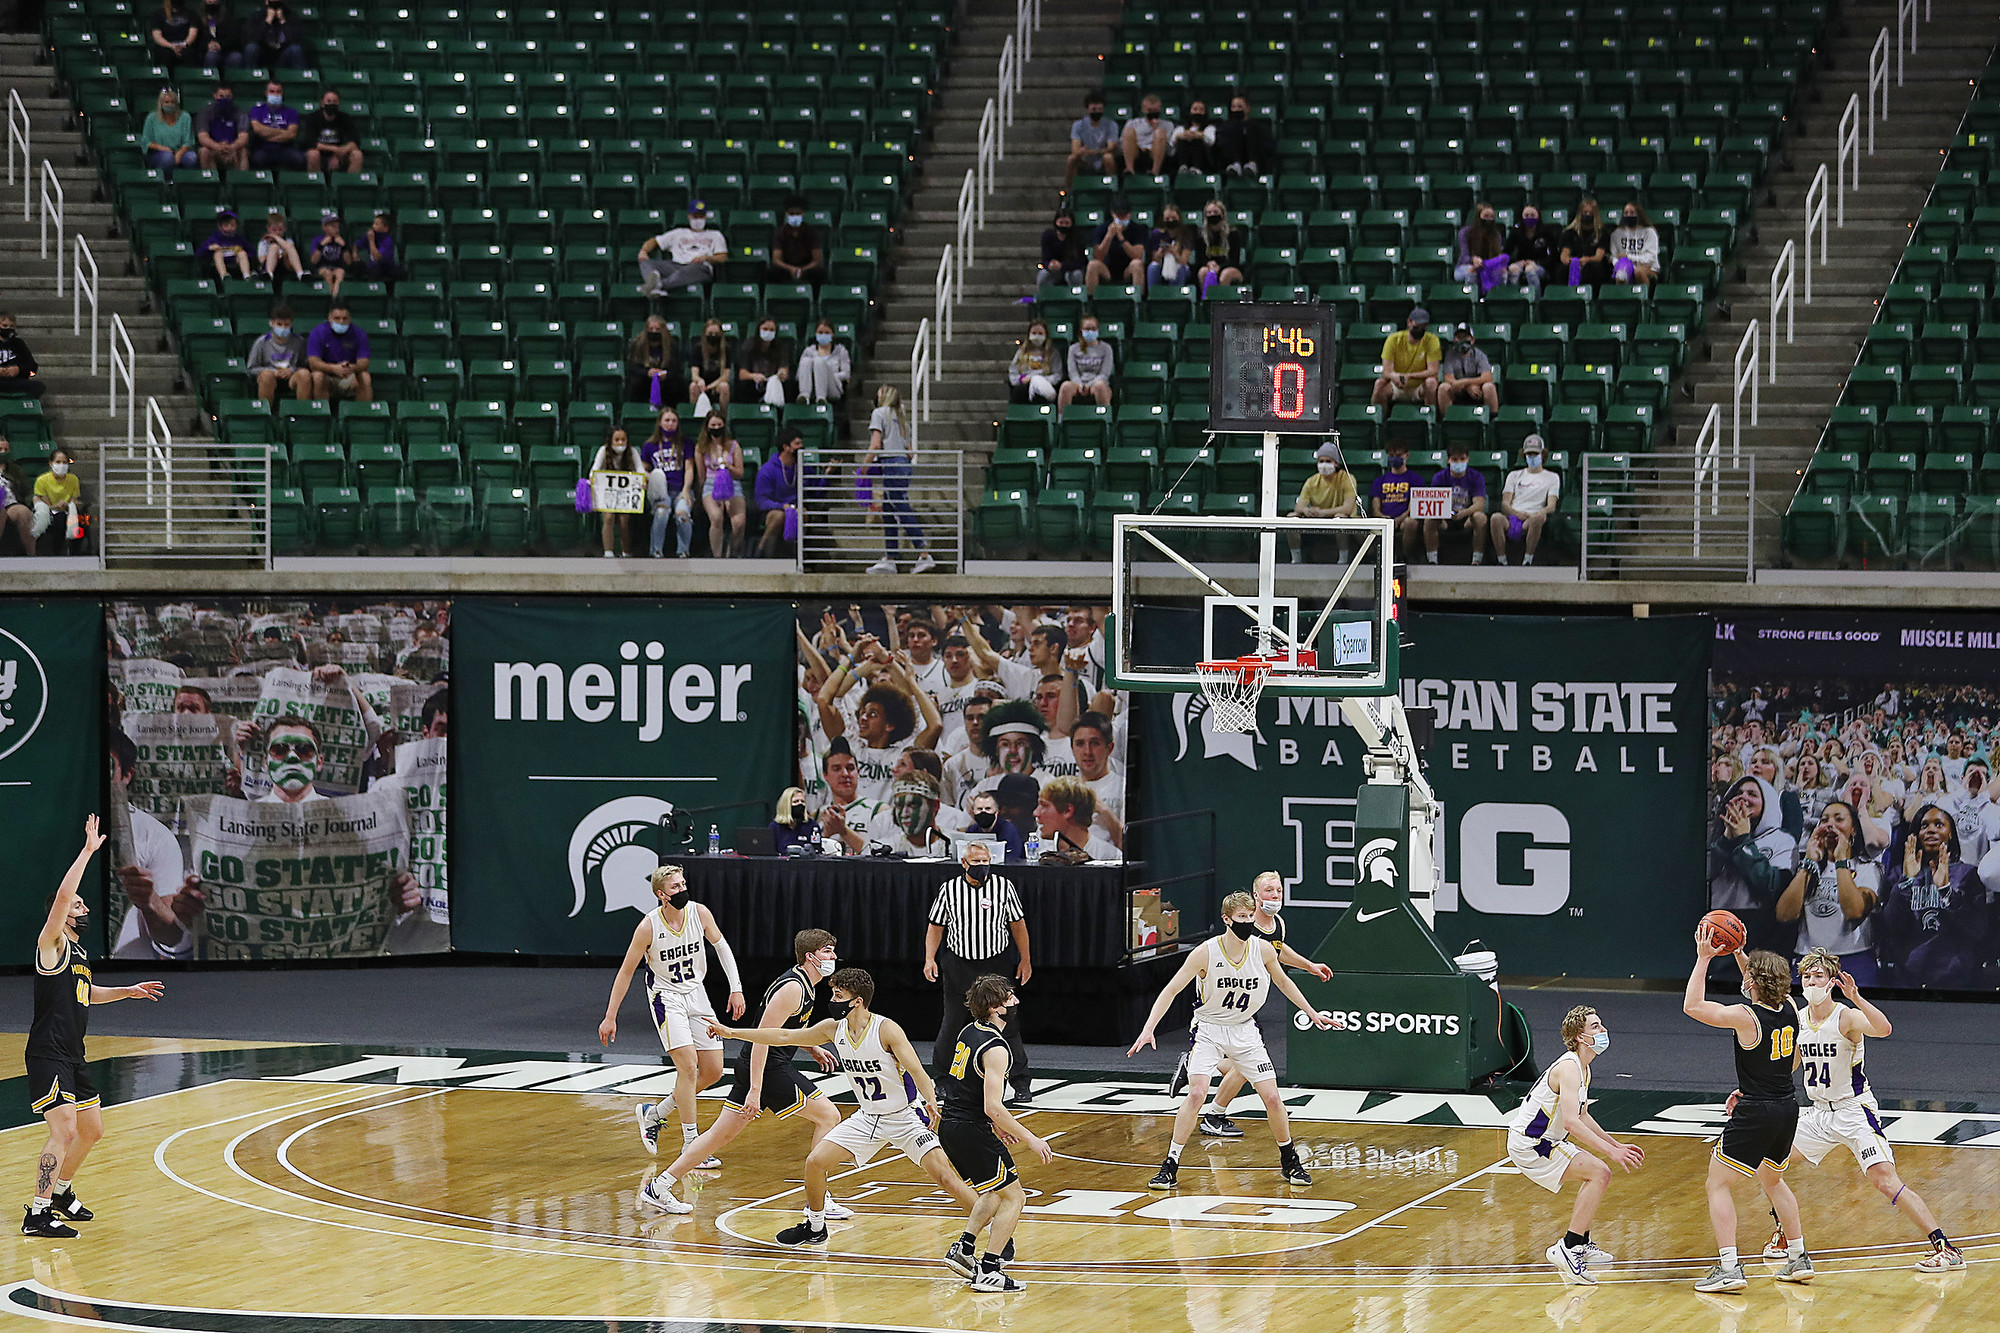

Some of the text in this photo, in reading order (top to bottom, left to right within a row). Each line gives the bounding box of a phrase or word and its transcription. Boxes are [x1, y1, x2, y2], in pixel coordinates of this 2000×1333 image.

[1263, 327, 1314, 357] 1:46
[1272, 362, 1305, 419] 0
[1382, 482, 1409, 493] SHS
[1412, 490, 1450, 499] EMERGENCY
[1418, 501, 1444, 516] EXIT
[1343, 635, 1367, 660] Sparrow
[1758, 629, 1880, 642] STRONG FEELS GOOD
[1901, 629, 1963, 648] MUSCLE
[494, 641, 752, 742] meijer
[1531, 682, 1677, 733] STATE
[220, 812, 377, 842] Lansing State Journal
[202, 848, 399, 887] GO STATE!
[201, 883, 247, 912] GO
[206, 912, 249, 941] GO
[660, 941, 700, 961] EAGLES
[669, 958, 695, 983] 33
[1217, 977, 1258, 990] EAGLES
[1222, 991, 1250, 1012] 44
[1365, 1012, 1460, 1036] SPORTS
[1770, 1025, 1794, 1061] 10
[842, 1058, 882, 1073] EAGLES
[1805, 1062, 1831, 1088] 24
